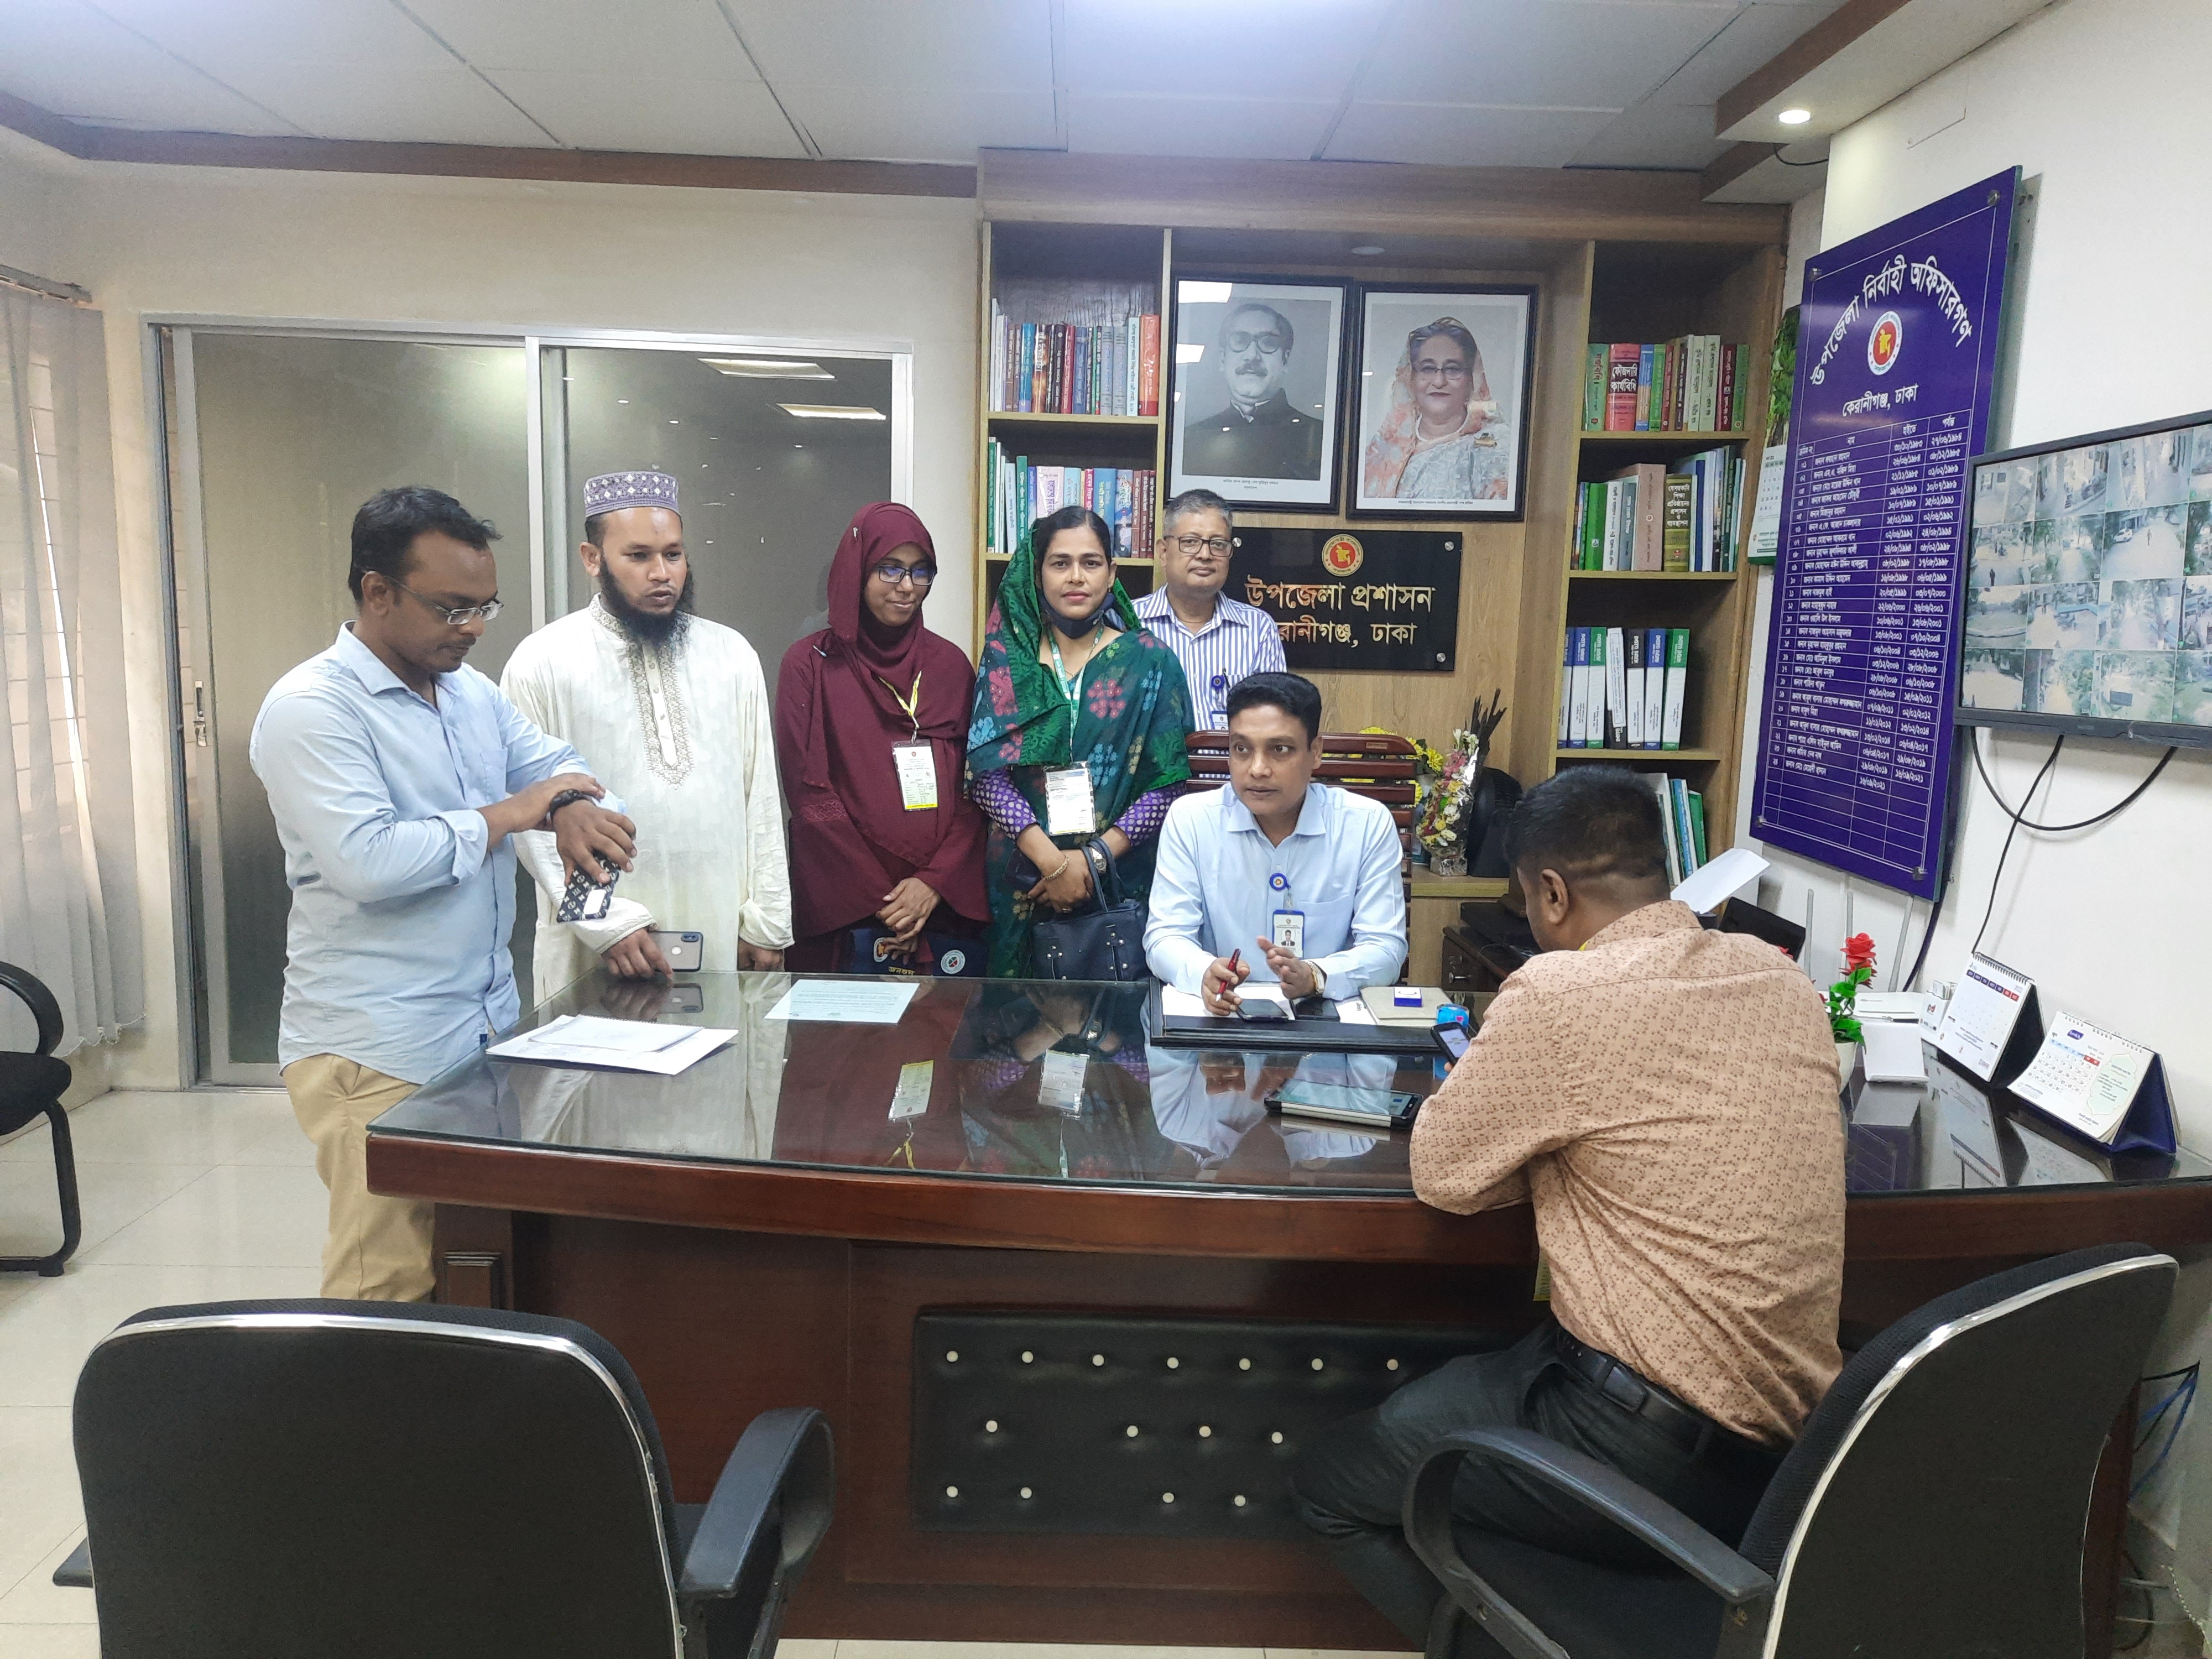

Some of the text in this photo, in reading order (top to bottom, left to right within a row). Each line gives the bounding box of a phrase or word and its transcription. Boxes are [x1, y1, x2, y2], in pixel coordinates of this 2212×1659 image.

[1810, 295, 1860, 384] উপজেলা
[1863, 254, 1907, 308] নির্বাহী
[1911, 255, 1971, 347] অফিসারগণ
[1895, 383, 1919, 405] ঢাকা
[1244, 574, 1436, 612] উপজেলা প্রশাসন
[1370, 622, 1418, 646] ঢাকা
